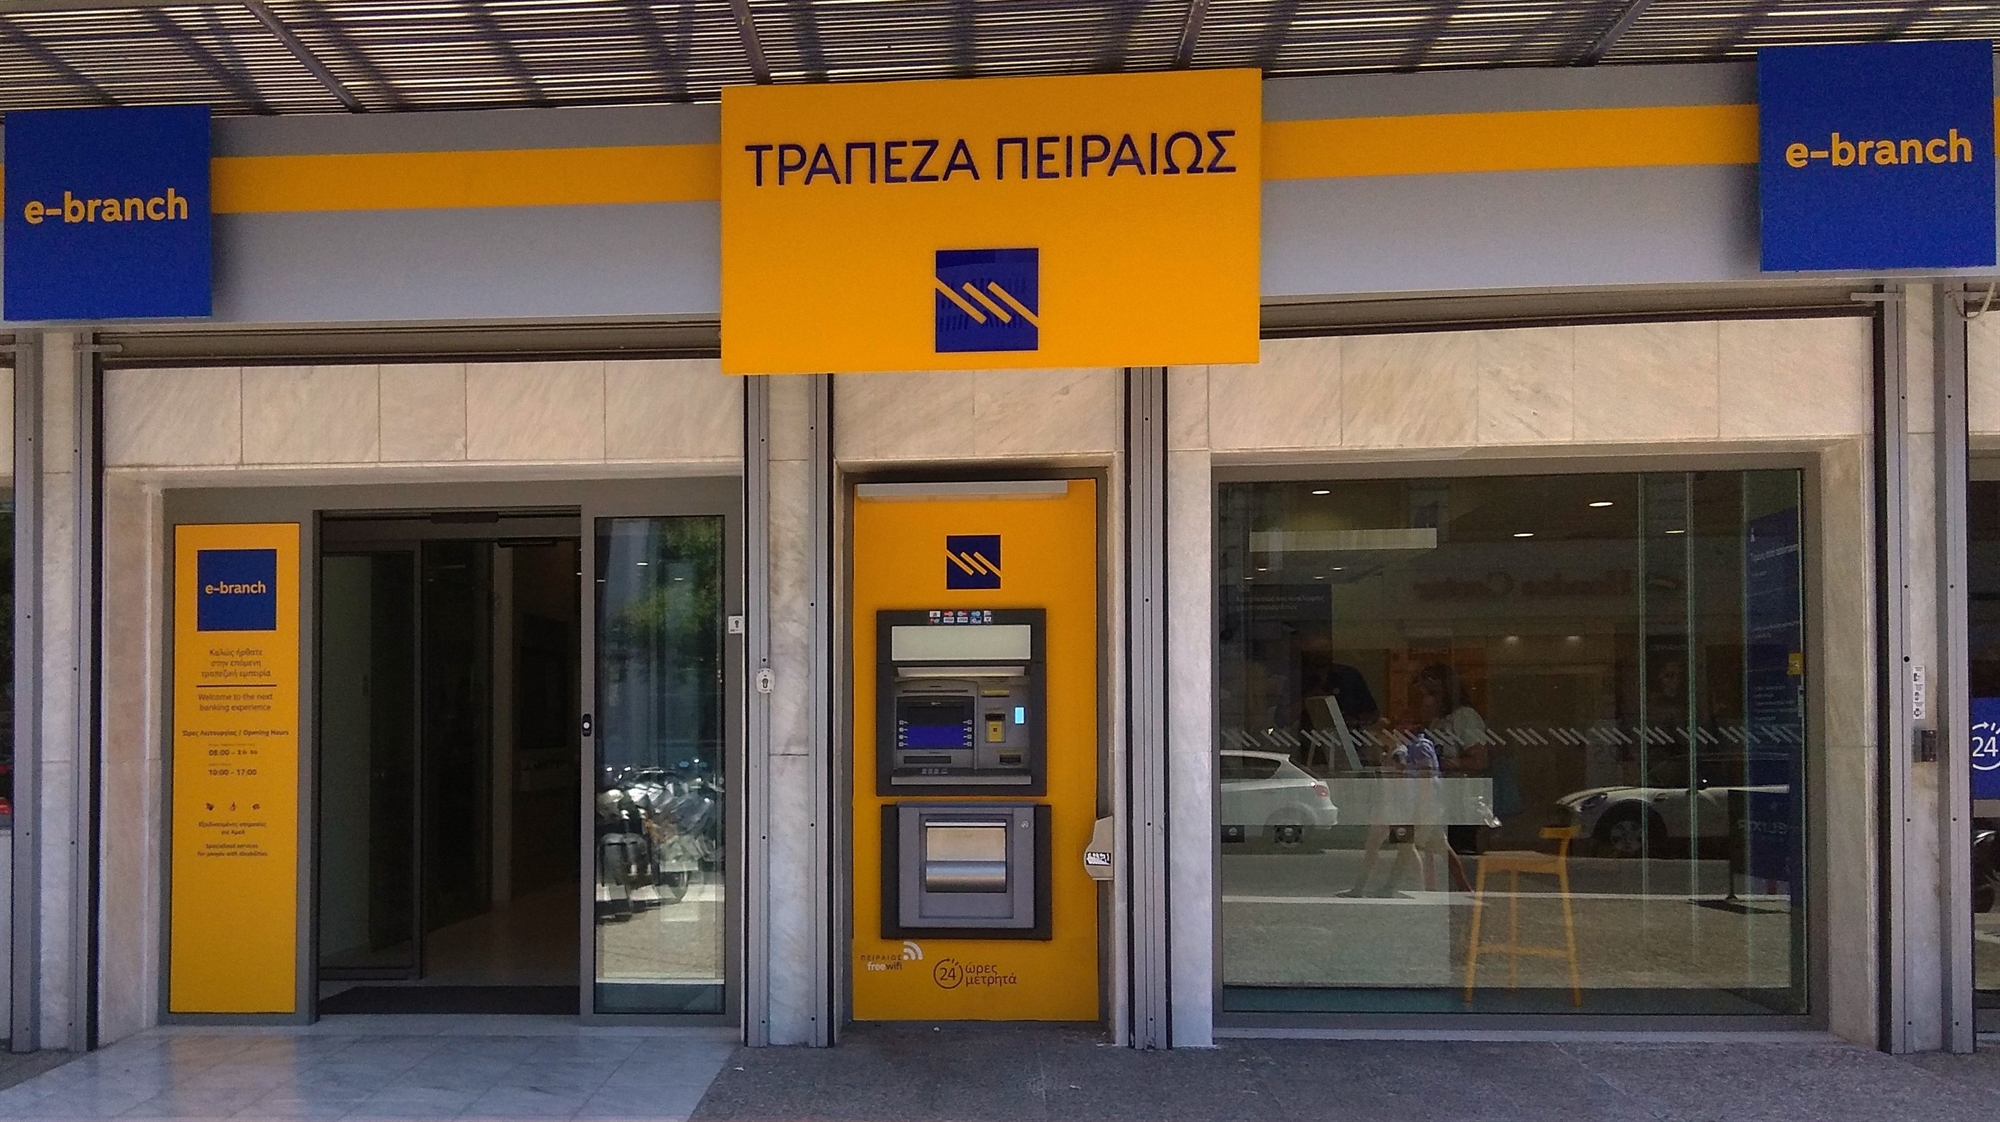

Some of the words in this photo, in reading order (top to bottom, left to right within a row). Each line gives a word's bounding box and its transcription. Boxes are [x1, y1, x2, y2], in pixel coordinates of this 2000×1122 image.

[1785, 128, 1973, 168] e-branch
[745, 138, 980, 187] ΤΡΑΠΕΖΑ
[996, 130, 1237, 180] ΠΕΙΡΑΙΩΣ
[24, 187, 189, 224] e-branch
[205, 580, 267, 595] e-branch
[198, 693, 232, 701] Welcome
[233, 693, 241, 701] to
[199, 704, 230, 712] banking
[231, 704, 271, 712] experience
[243, 729, 270, 737] Opening
[1972, 736, 1998, 758] 24
[940, 967, 957, 981] 24
[965, 961, 998, 976] ώρες
[965, 972, 1018, 988] μετρητά
